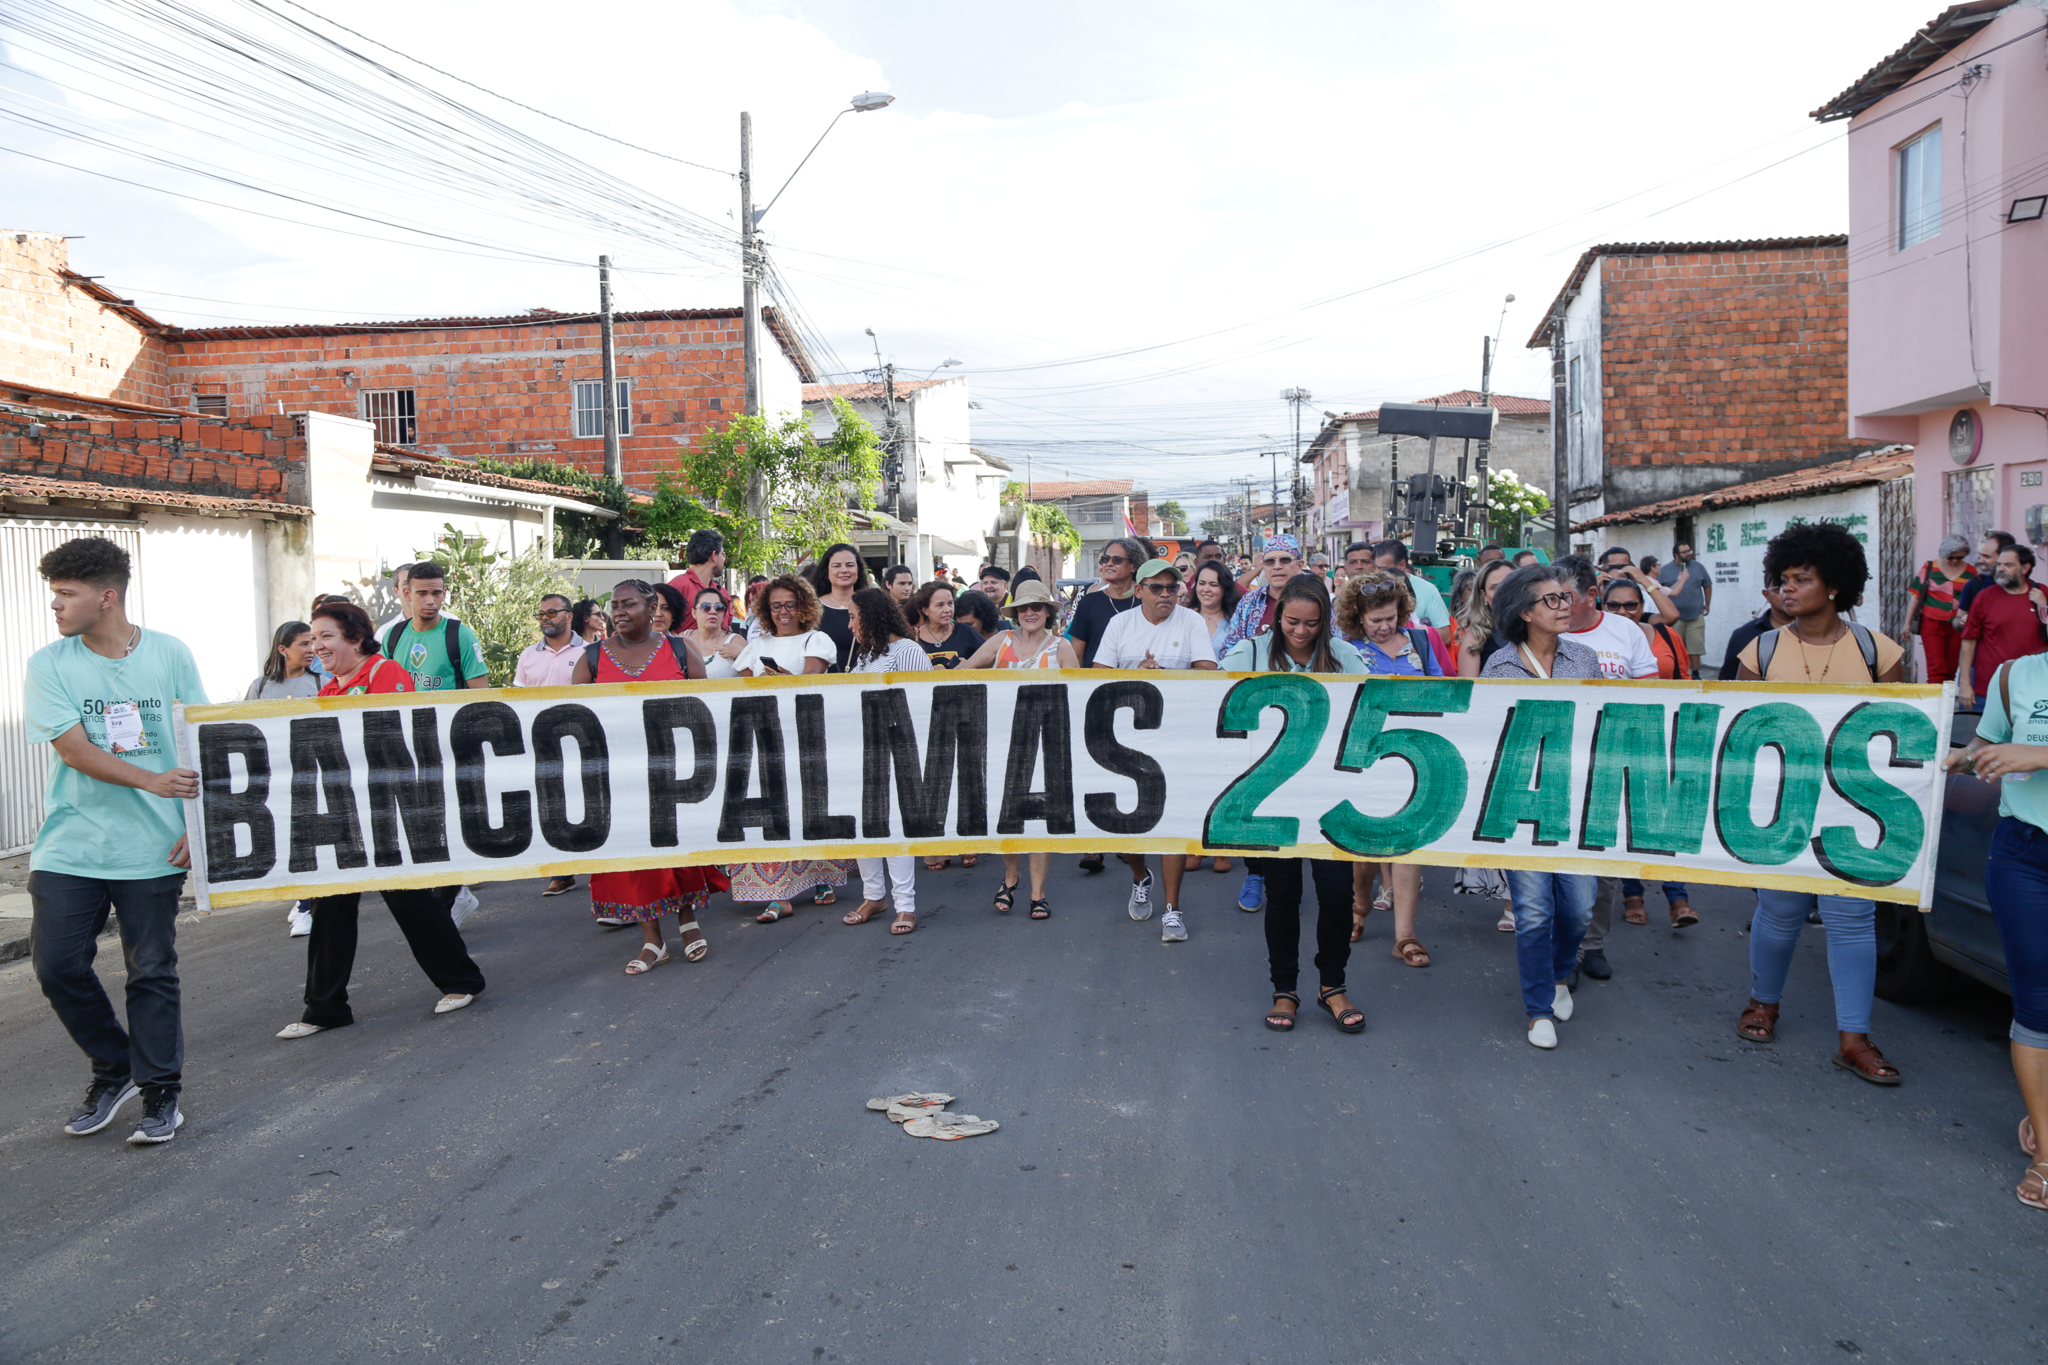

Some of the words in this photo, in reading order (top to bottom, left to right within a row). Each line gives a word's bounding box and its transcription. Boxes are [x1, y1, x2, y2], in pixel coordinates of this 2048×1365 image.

[2021, 472, 2041, 487] 290
[83, 699, 105, 716] 50
[83, 714, 106, 723] anos
[124, 748, 162, 758] PALMEIRAS
[199, 700, 611, 884] BANCO
[642, 680, 1167, 847] PALMAS
[1201, 674, 1475, 857] 25
[1472, 700, 1939, 887] ANOS
